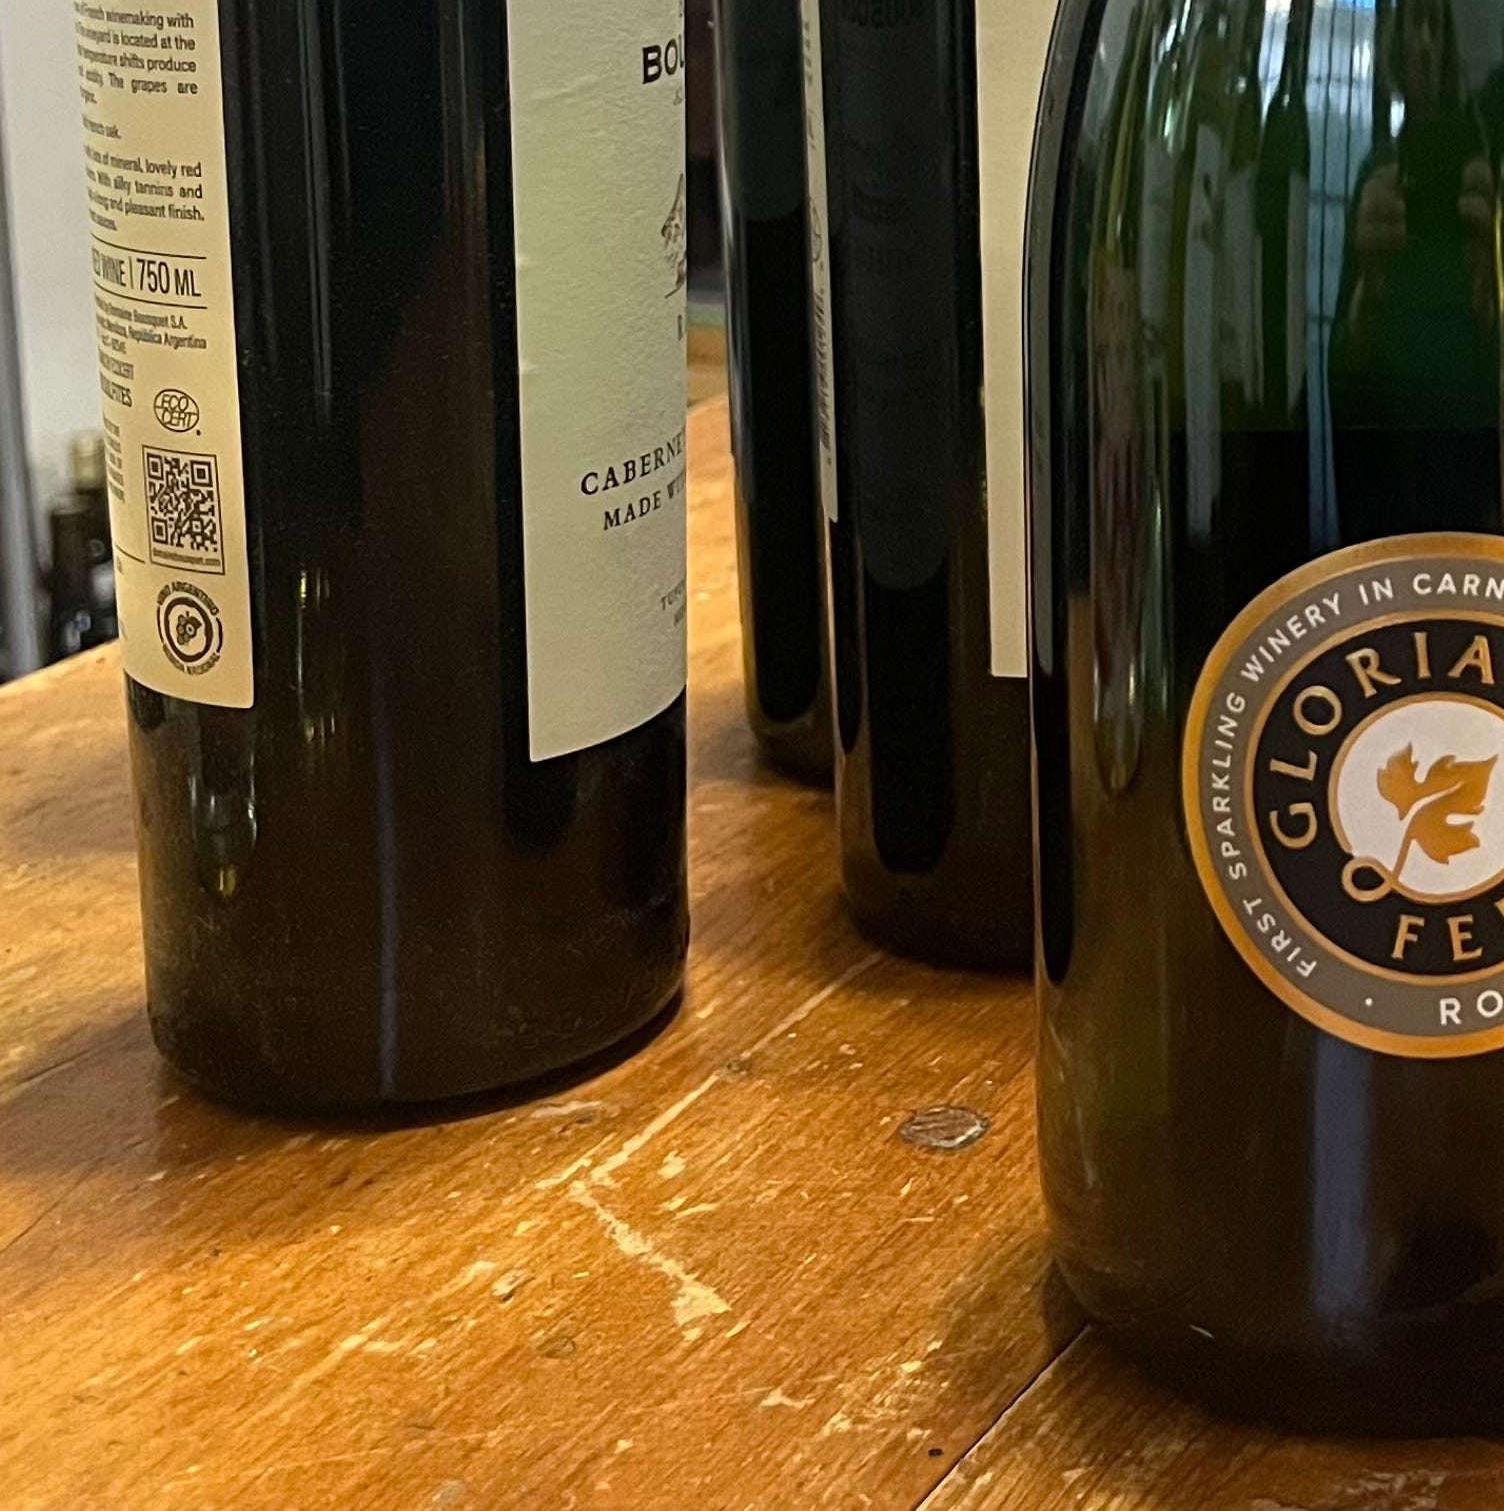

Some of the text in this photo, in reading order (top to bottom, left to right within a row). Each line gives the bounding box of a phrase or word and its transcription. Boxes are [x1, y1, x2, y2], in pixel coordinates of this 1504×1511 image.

[166, 13, 194, 29] with
[121, 30, 158, 49] located
[174, 35, 195, 50] the
[146, 57, 197, 72] produce
[131, 79, 167, 94] grapes
[178, 82, 198, 95] are
[145, 158, 178, 179] lovely
[181, 161, 202, 178] red
[179, 183, 203, 199] and
[168, 204, 205, 222] finish.
[137, 257, 170, 295] 750
[175, 268, 201, 297] ML
[603, 490, 662, 530] MADE
[1358, 576, 1395, 606] IN
[1240, 592, 1341, 683] WINERY
[1270, 631, 1496, 849] GLORIA
[1211, 691, 1248, 881] SPARKLING
[1243, 895, 1317, 979] FIRST
